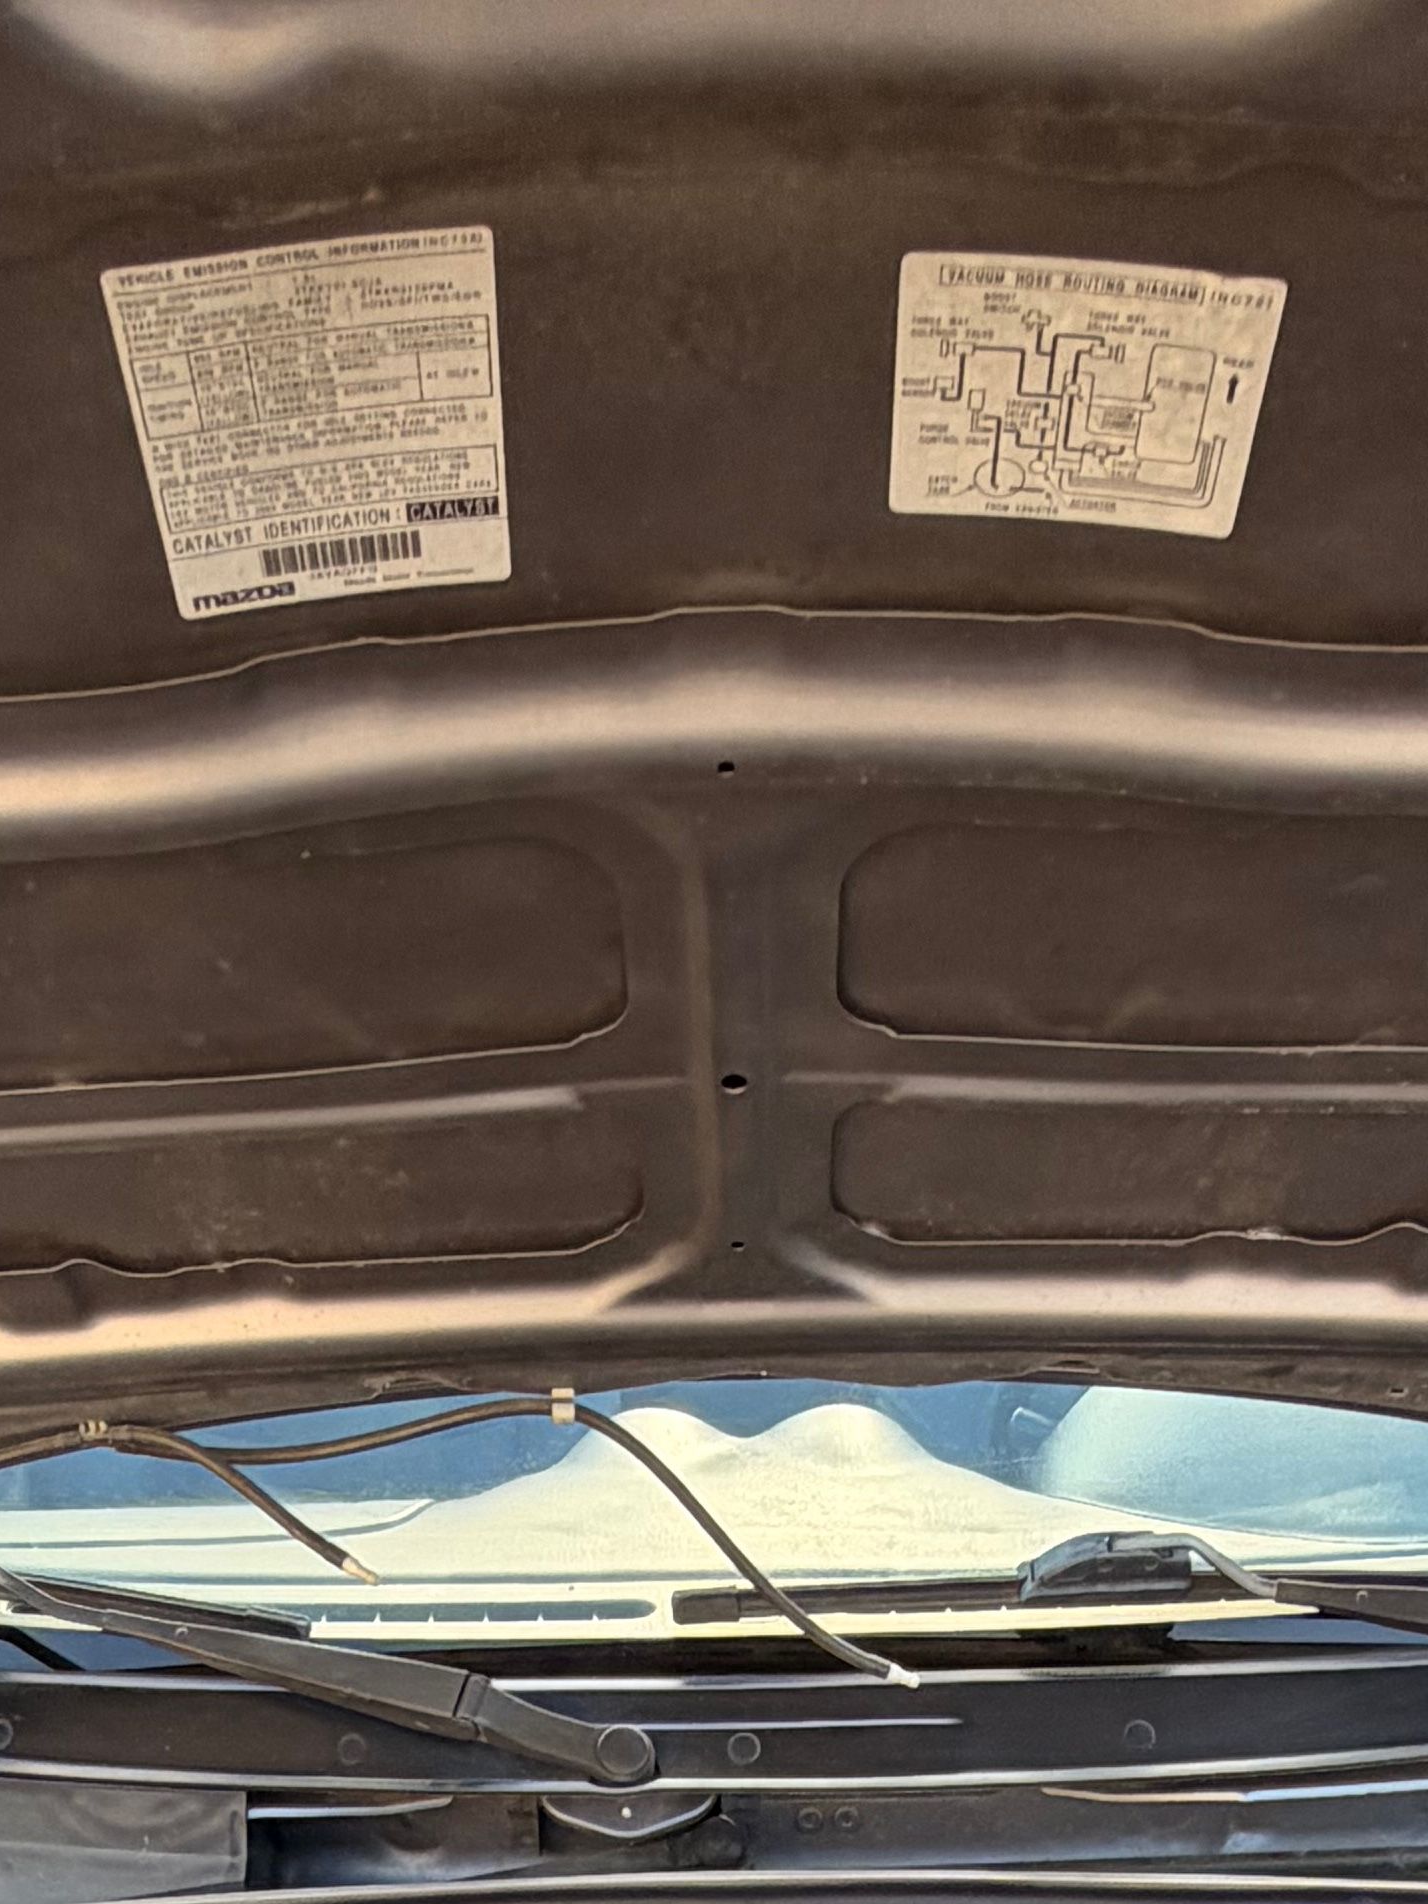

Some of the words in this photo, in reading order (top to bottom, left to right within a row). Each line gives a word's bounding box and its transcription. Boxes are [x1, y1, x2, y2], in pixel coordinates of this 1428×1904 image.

[118, 269, 174, 288] VEHICLE
[184, 259, 248, 278] EMISSION
[256, 249, 319, 268] CONTROL
[328, 238, 420, 258] INFORMATION
[948, 267, 1005, 286] VACUUM
[1015, 272, 1051, 289] HOSE
[1062, 275, 1125, 294] ROUTING
[1135, 280, 1200, 300] DIAGRAM
[172, 526, 252, 555] CATALYST
[263, 507, 390, 540] IDENTIFICATION
[410, 498, 495, 520] CATALYST
